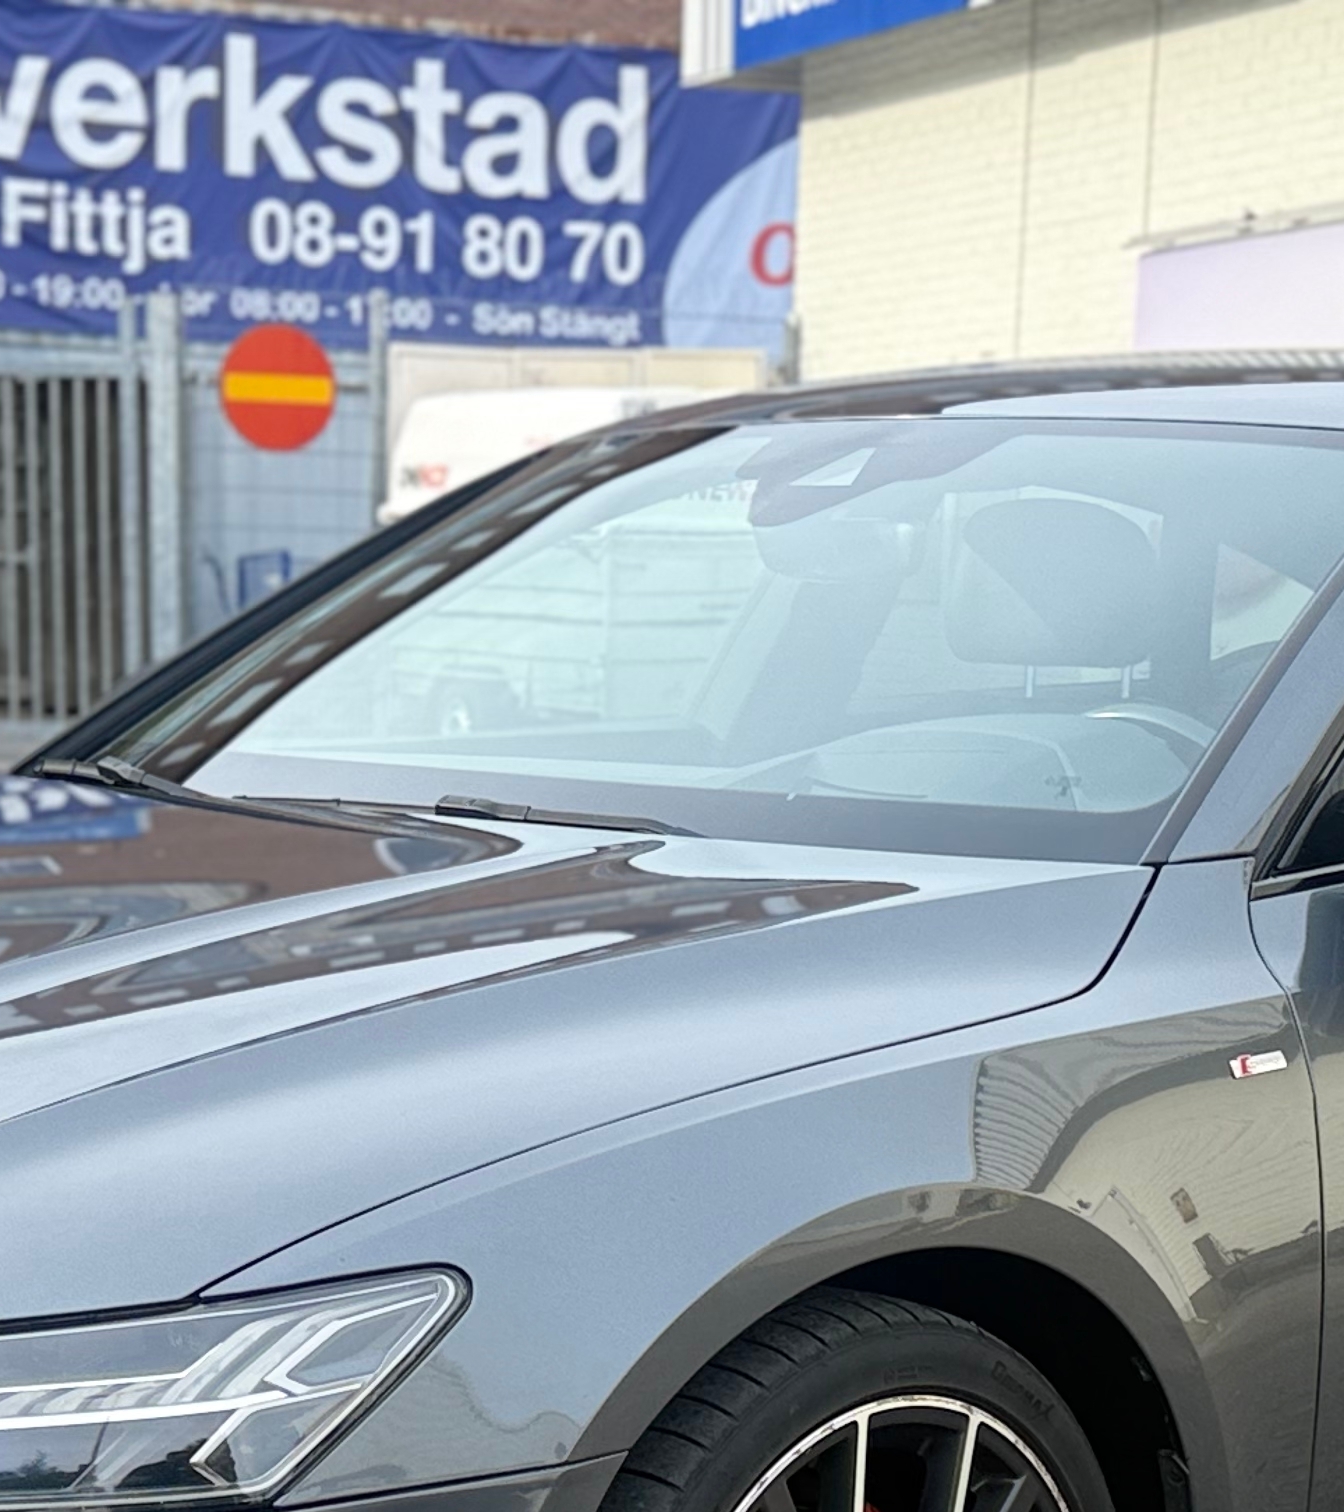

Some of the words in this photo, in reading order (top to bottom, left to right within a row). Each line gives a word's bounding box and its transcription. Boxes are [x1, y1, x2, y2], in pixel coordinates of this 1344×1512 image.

[0, 176, 192, 274] Fittja
[250, 198, 436, 274] 08-91
[461, 213, 545, 282] 80
[562, 220, 645, 286] 70
[345, 295, 433, 331] 1:00
